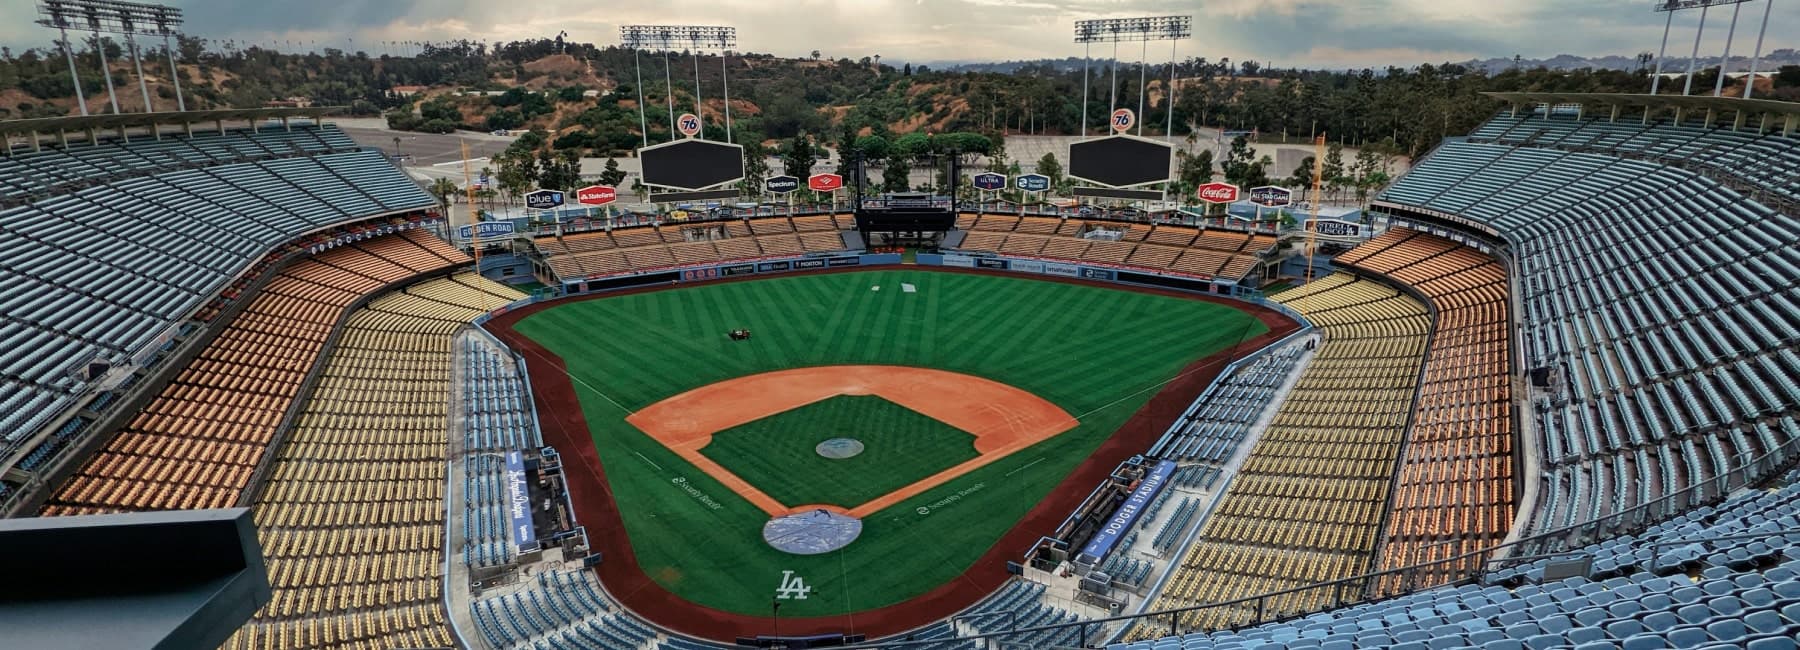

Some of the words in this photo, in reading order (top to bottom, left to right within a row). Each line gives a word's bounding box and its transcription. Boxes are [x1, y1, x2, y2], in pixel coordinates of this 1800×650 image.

[683, 118, 698, 130] 76
[1114, 114, 1129, 126] 76
[529, 194, 551, 204] blue
[463, 225, 490, 237] GODEN
[492, 223, 511, 232] ROAD
[1105, 504, 1138, 535] DODGER
[1132, 475, 1162, 503] STADIUM
[776, 570, 811, 600] LA
